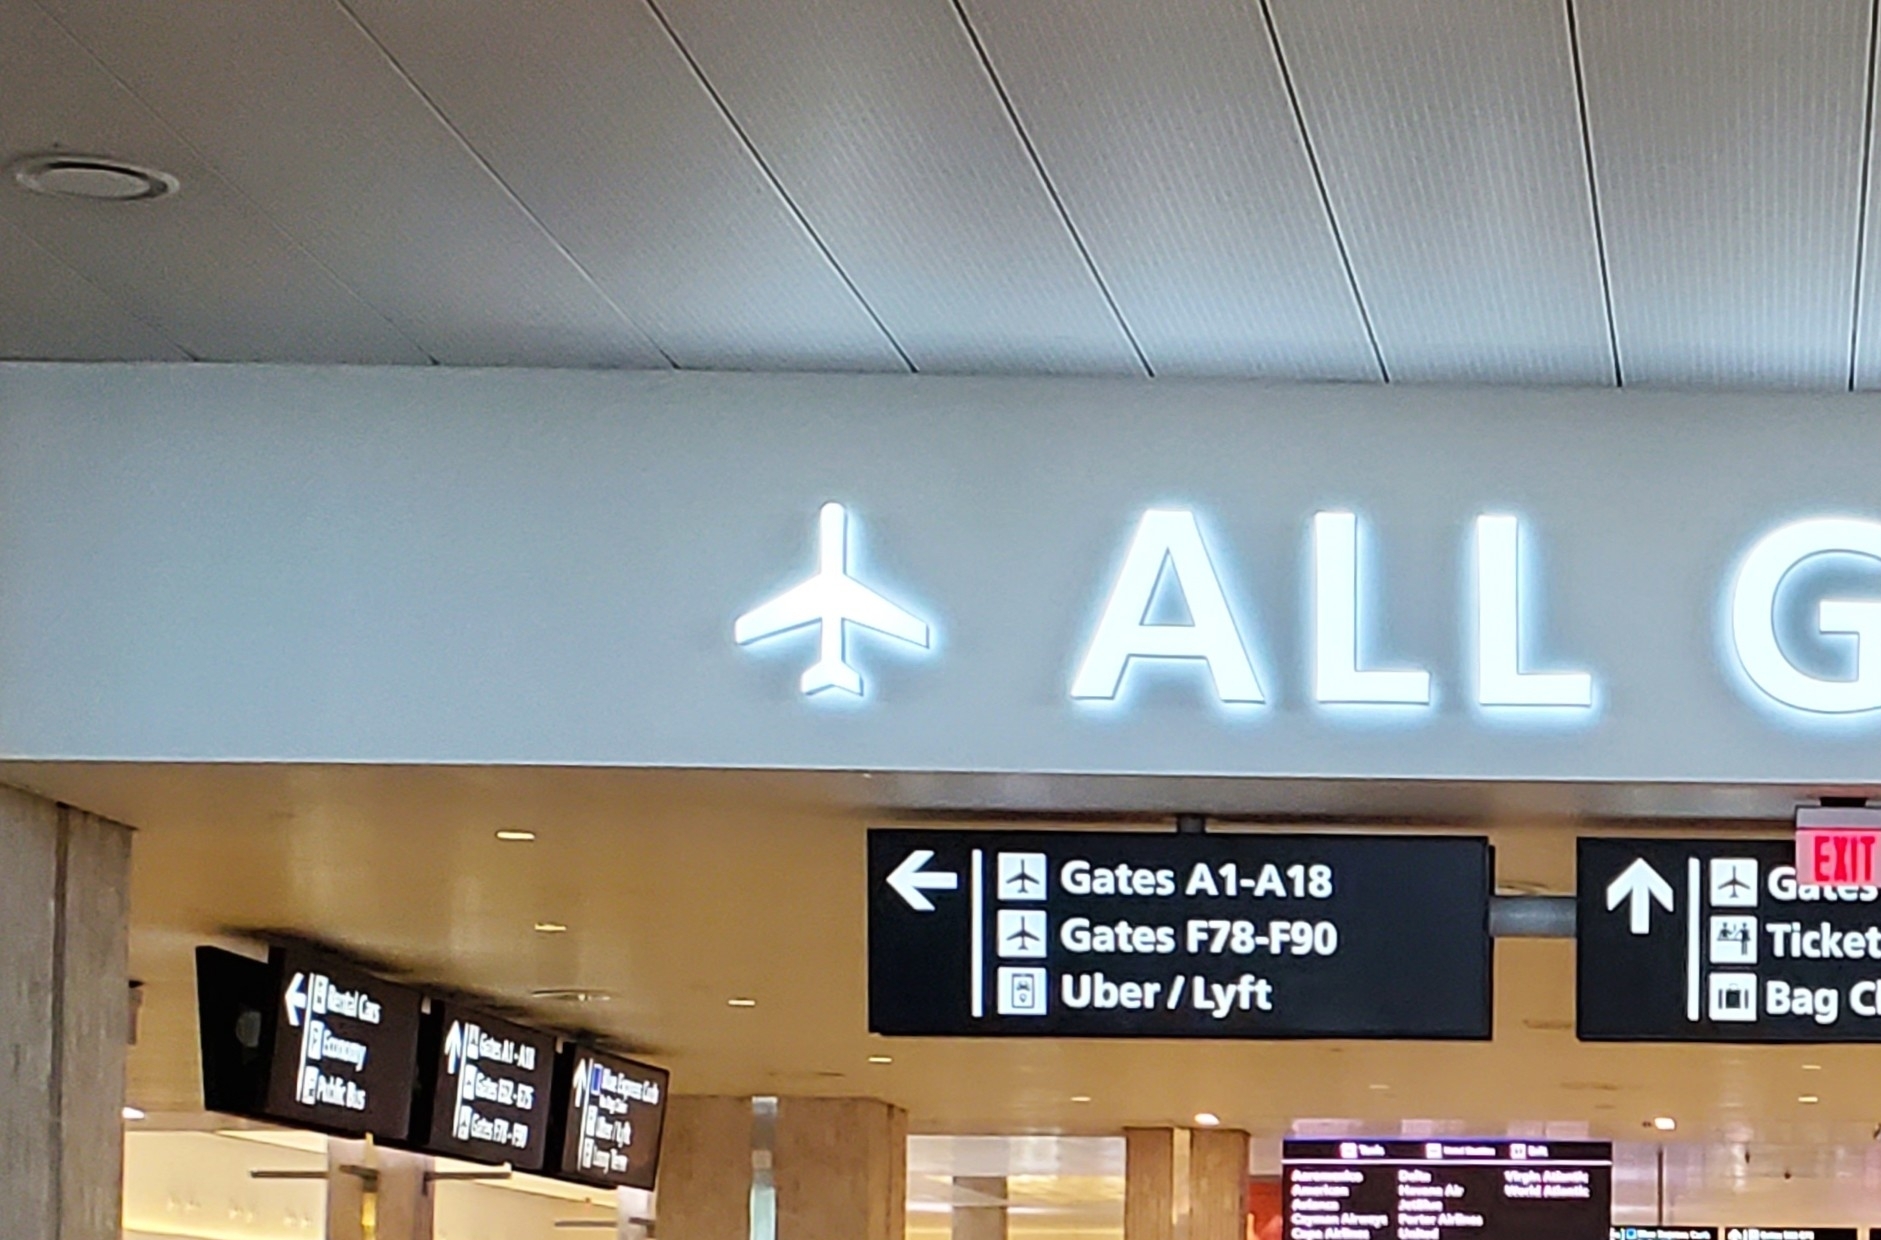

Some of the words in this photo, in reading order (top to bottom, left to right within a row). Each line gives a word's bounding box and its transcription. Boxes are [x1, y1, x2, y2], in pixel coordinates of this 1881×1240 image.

[1070, 510, 1592, 706] ALL
[1060, 860, 1175, 896] Gates
[1186, 864, 1333, 898] A1-A18
[1814, 835, 1876, 882] EXIT
[1060, 918, 1175, 953] Gates
[1187, 920, 1338, 955] F78-F90
[1061, 974, 1160, 1009] Uber
[1192, 975, 1273, 1018] Lyft
[1766, 980, 1839, 1024] Bag
